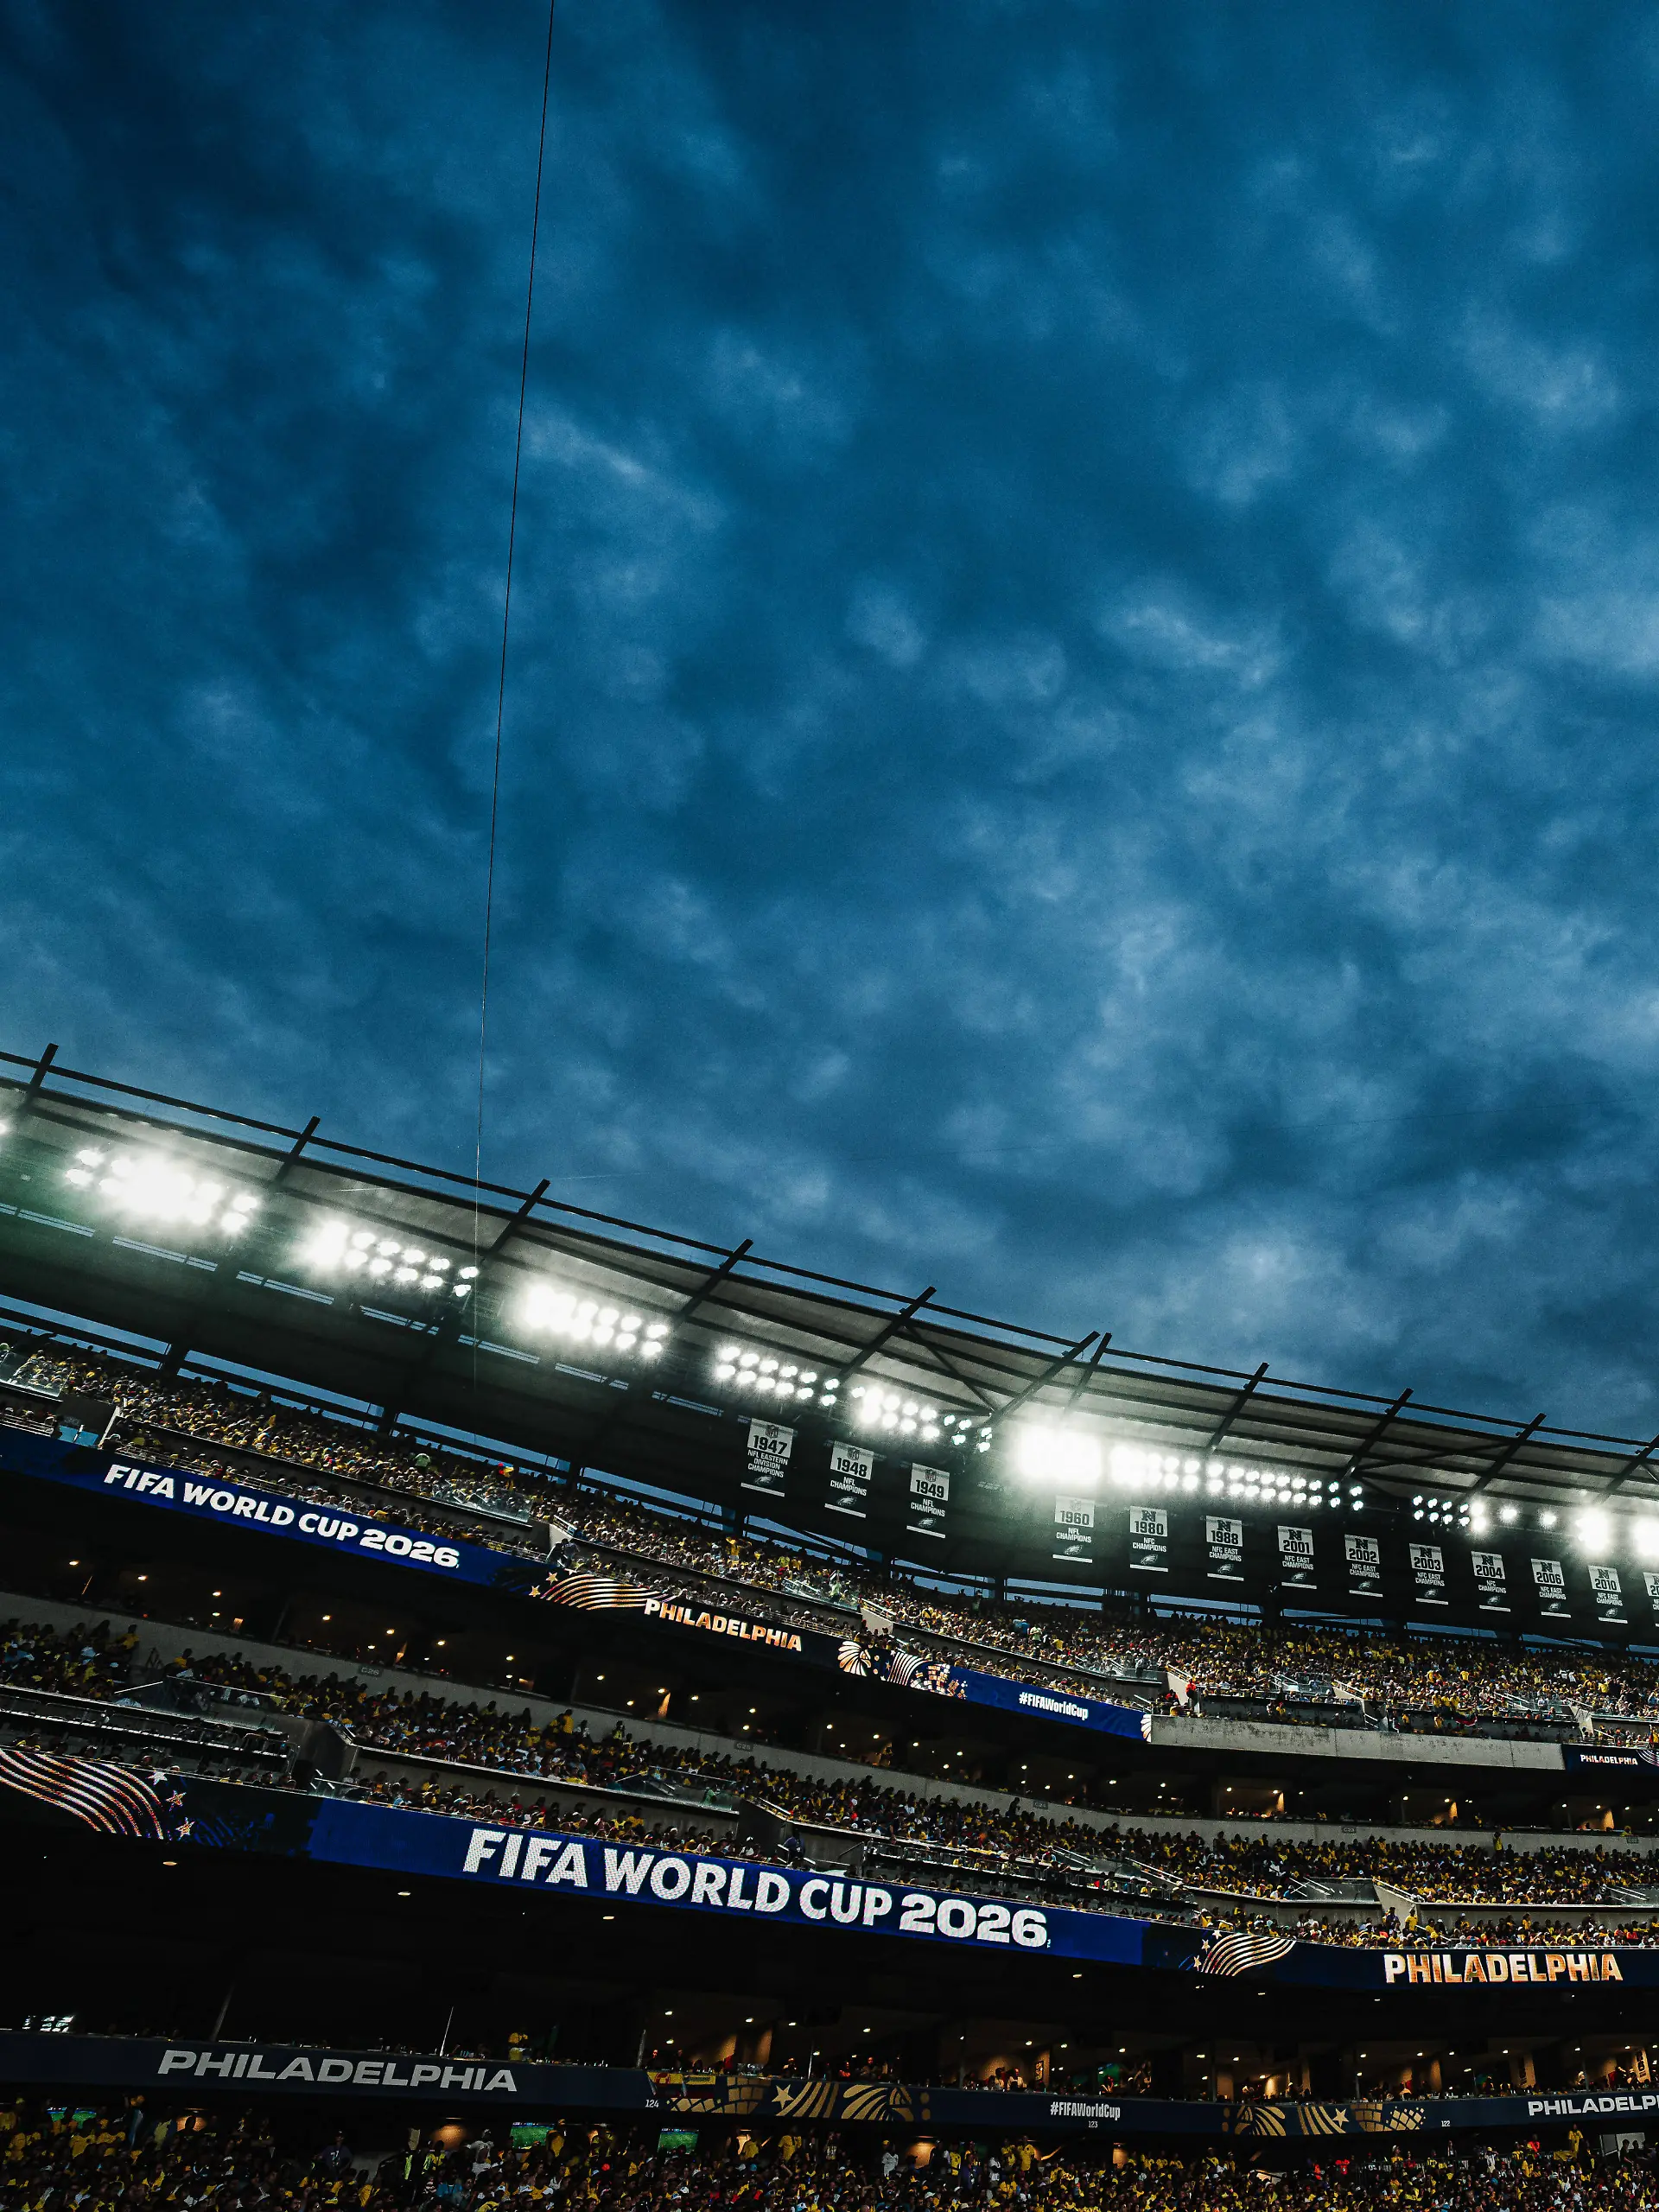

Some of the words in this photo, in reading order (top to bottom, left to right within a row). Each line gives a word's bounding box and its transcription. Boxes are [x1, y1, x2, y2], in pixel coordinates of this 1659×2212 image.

[753, 1434, 788, 1455] 1947
[747, 1449, 759, 1458] NFL
[760, 1452, 788, 1465] EASTERN
[753, 1458, 780, 1470] DIVISION
[747, 1463, 785, 1478] CHAMPIONS
[836, 1457, 868, 1478] 1948
[830, 1479, 868, 1497] CHAMPIONS
[843, 1476, 855, 1486] NFL
[916, 1479, 944, 1498] 1949
[104, 1464, 174, 1499] FIFA
[183, 1482, 295, 1526] WORLD
[298, 1513, 359, 1541] CUP
[911, 1502, 945, 1517] CHAMPIONS
[923, 1498, 934, 1507] NFL
[1060, 1510, 1090, 1525] 1960
[1068, 1527, 1080, 1535] NFL
[1134, 1521, 1164, 1535] 1980
[1056, 1532, 1092, 1543] CHAMPIONS
[1211, 1530, 1239, 1545] 1988
[1132, 1542, 1166, 1553] CHAMPIONS
[1224, 1547, 1238, 1555] EAST
[1283, 1540, 1309, 1554] 2001
[1209, 1552, 1242, 1562] CHAMPIONS
[1349, 1548, 1377, 1562] 2002
[1282, 1560, 1313, 1570] CHAMPIONS
[1414, 1557, 1441, 1570] 2003
[1350, 1568, 1380, 1579] CHAMPIONS
[1476, 1565, 1503, 1578] 2004
[1536, 1572, 1562, 1584] 2006
[1415, 1578, 1445, 1586] CHAMPIONS
[1478, 1585, 1507, 1593] CHAMPIONS
[1595, 1579, 1617, 1591] 2010
[1539, 1592, 1567, 1600] CHAMPIONS
[644, 1599, 802, 1652] PHILADELPHIA
[1019, 1691, 1089, 1720] #FIFAWorldCup
[1580, 1754, 1638, 1765] PHILADELPHIA
[462, 1828, 588, 1888] FIFA
[604, 1847, 791, 1913] WORLD
[799, 1878, 893, 1926] CUP
[1383, 1954, 1624, 1983] PHILADELPHIA
[157, 2050, 518, 2092] PHILADELPHIA
[645, 2099, 659, 2108] 124
[1528, 2094, 1659, 2116] PHILADELP
[1050, 2101, 1121, 2121] #FIFAWorldCup
